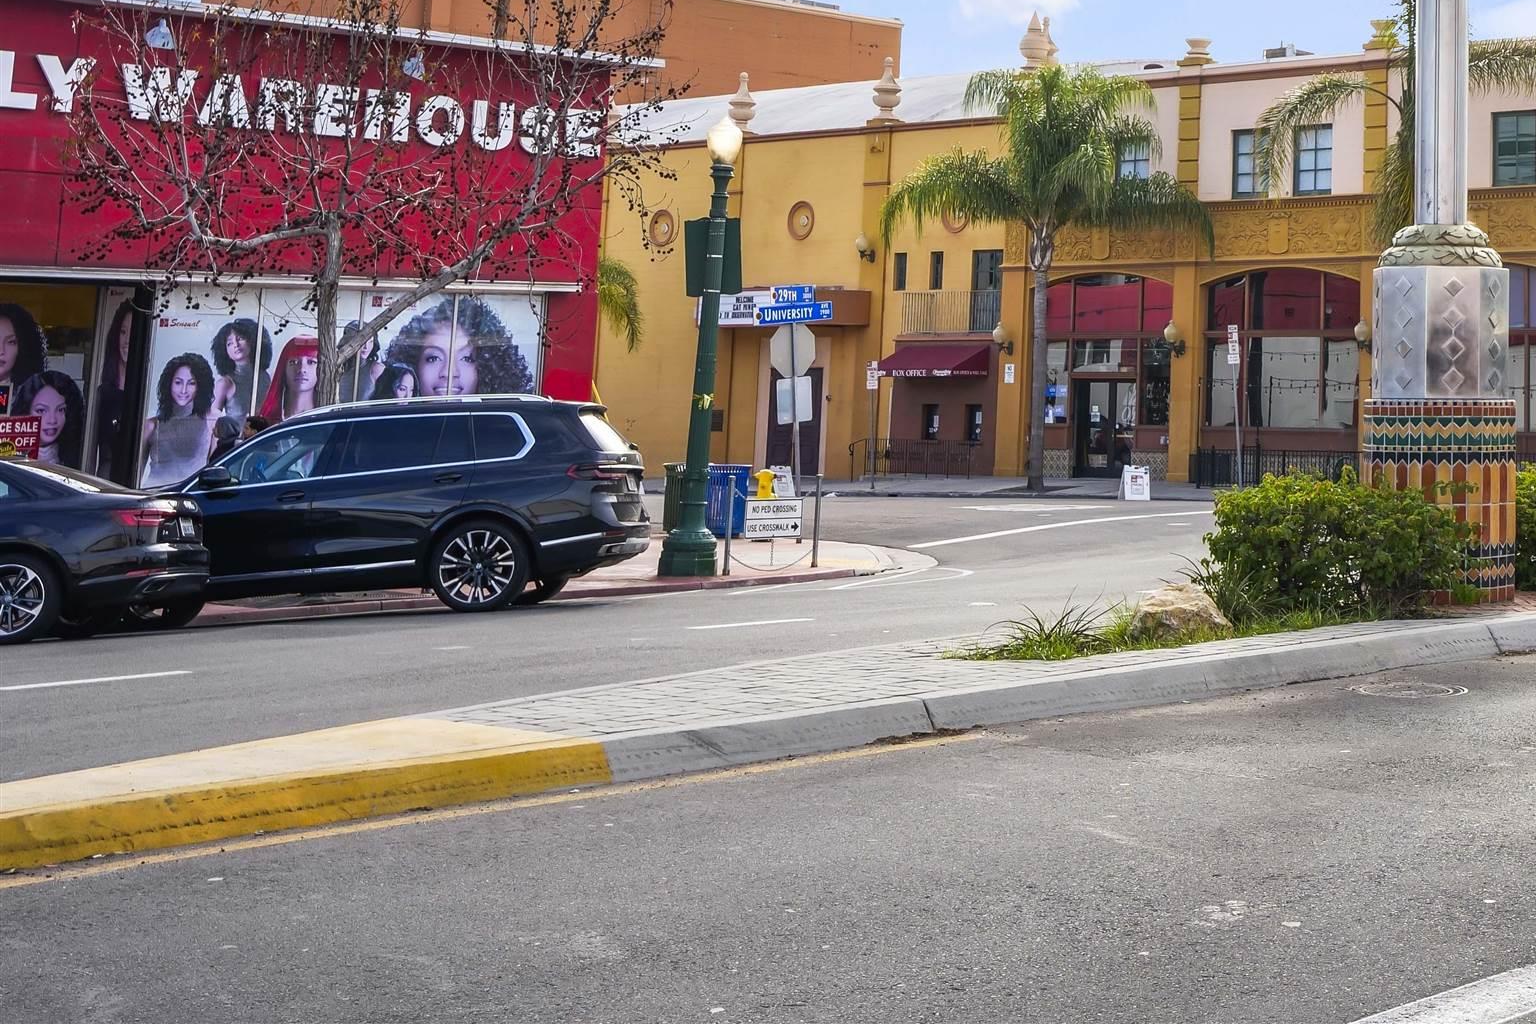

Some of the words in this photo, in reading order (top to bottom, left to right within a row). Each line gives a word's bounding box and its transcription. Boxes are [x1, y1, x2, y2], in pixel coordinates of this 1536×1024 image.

[0, 50, 97, 113] LY
[121, 63, 605, 159] WAREHOUSE
[778, 289, 797, 301] 29TH
[893, 369, 905, 377] BOX
[906, 369, 926, 377] OFFICE
[15, 422, 38, 432] SALE
[15, 437, 36, 446] OFF
[752, 506, 760, 514] NO
[761, 505, 771, 513] PED
[772, 505, 797, 513] CROSSING
[747, 524, 757, 532] USE
[758, 523, 789, 532] CROSSWALK
